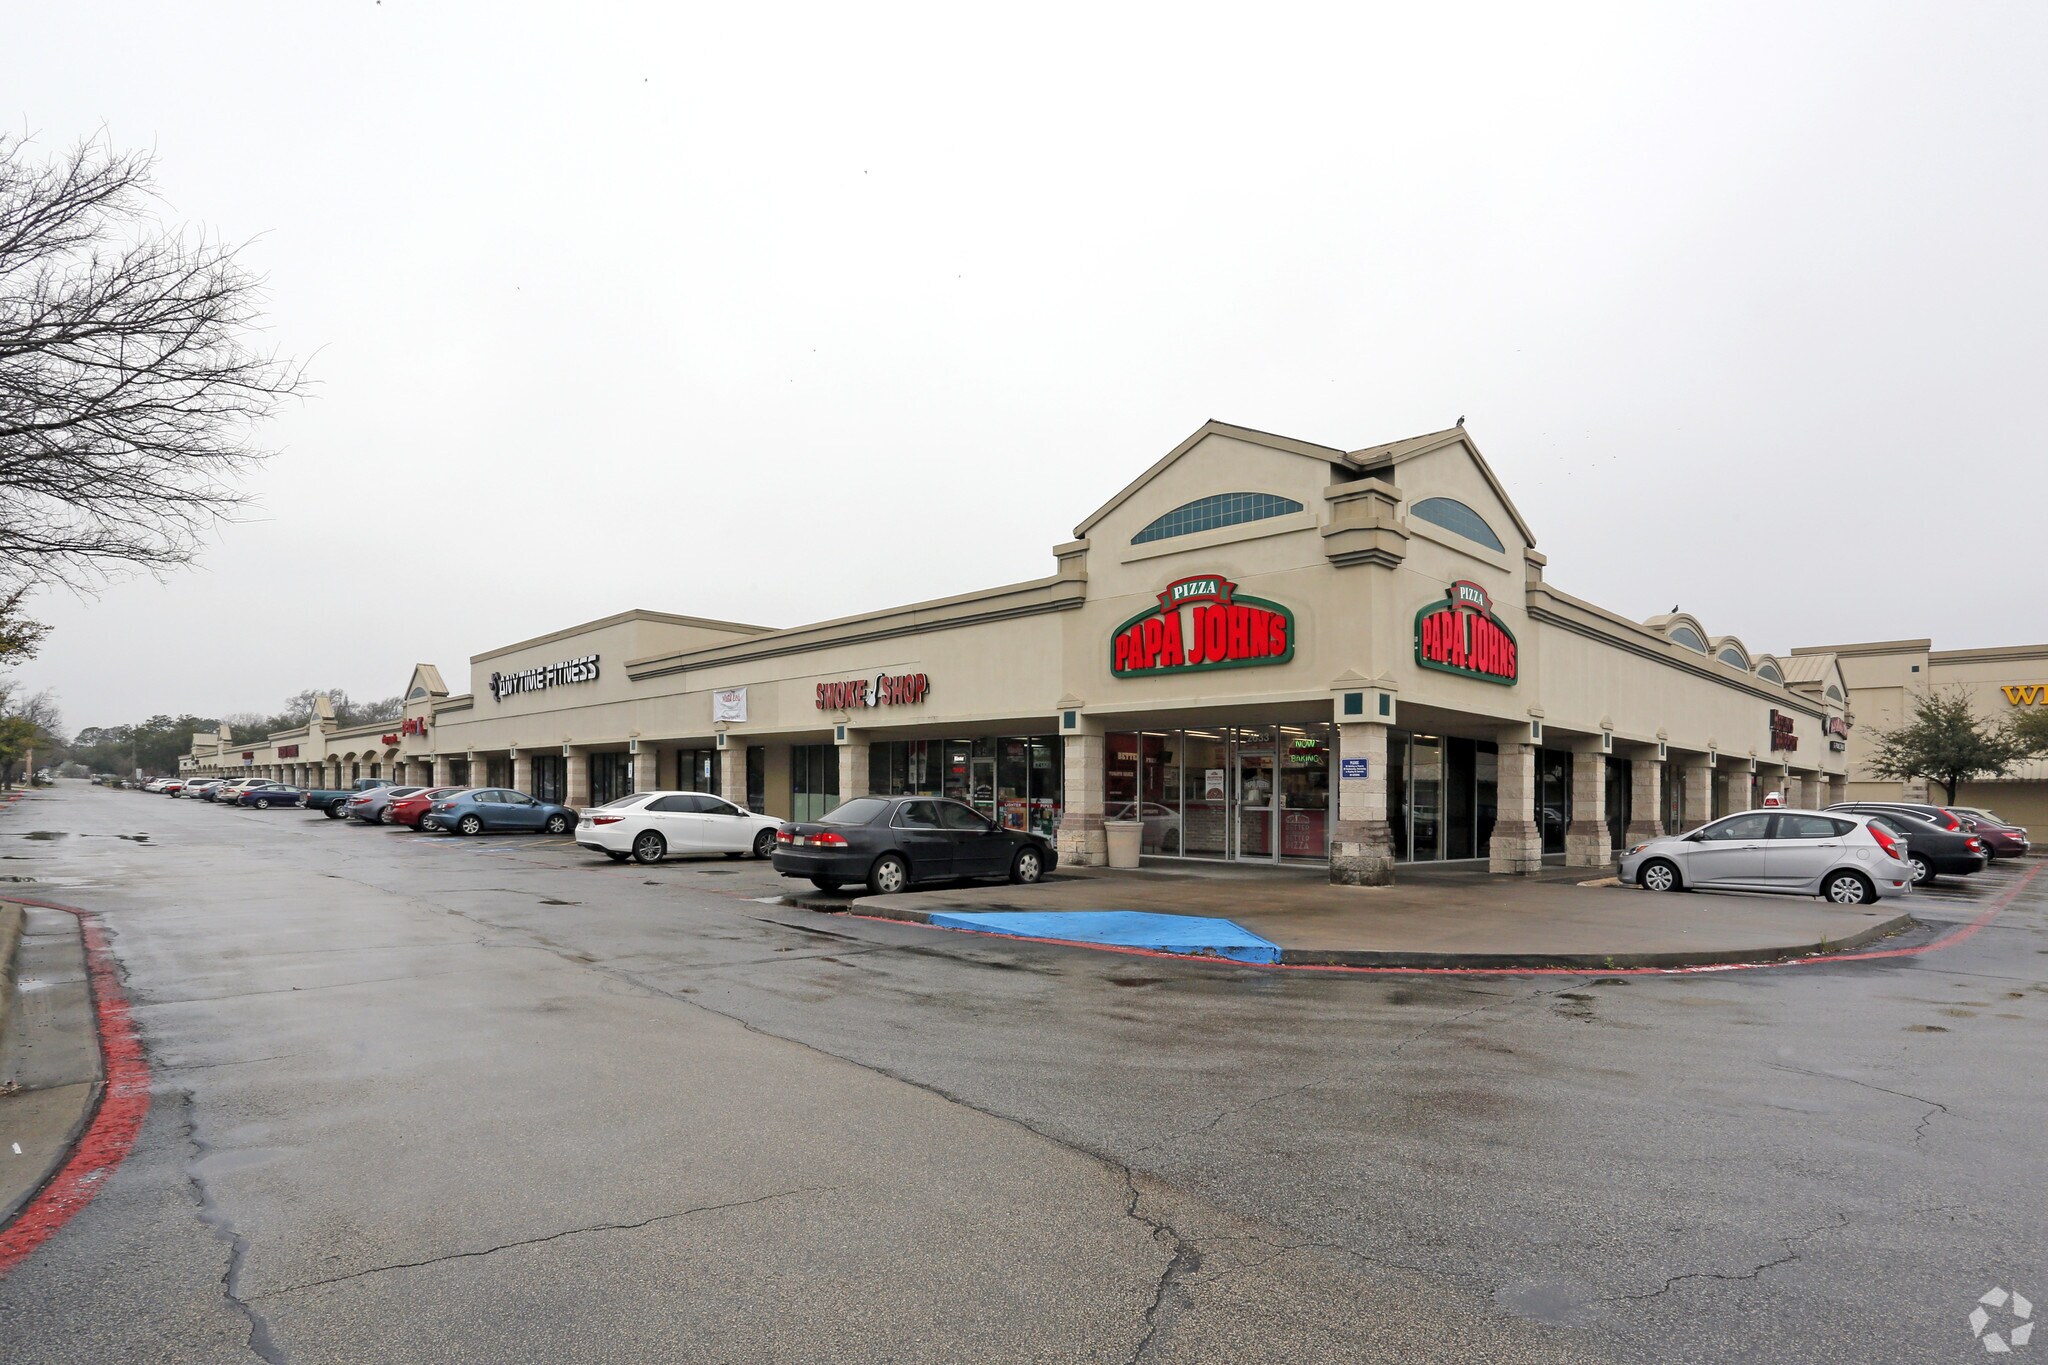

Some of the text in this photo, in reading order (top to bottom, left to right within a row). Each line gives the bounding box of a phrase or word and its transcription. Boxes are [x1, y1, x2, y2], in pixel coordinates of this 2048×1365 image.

[1174, 581, 1217, 600] PIZZA
[1460, 586, 1484, 607] PIZZA
[1115, 604, 1288, 671] PAPA JOHN'S
[1422, 611, 1466, 667] PAPA
[499, 654, 600, 697] ANYTIME FITNESS
[816, 673, 929, 710] SMOKE SHOP
[1291, 754, 1319, 763] BAKING
[1295, 740, 1315, 748] NOW
